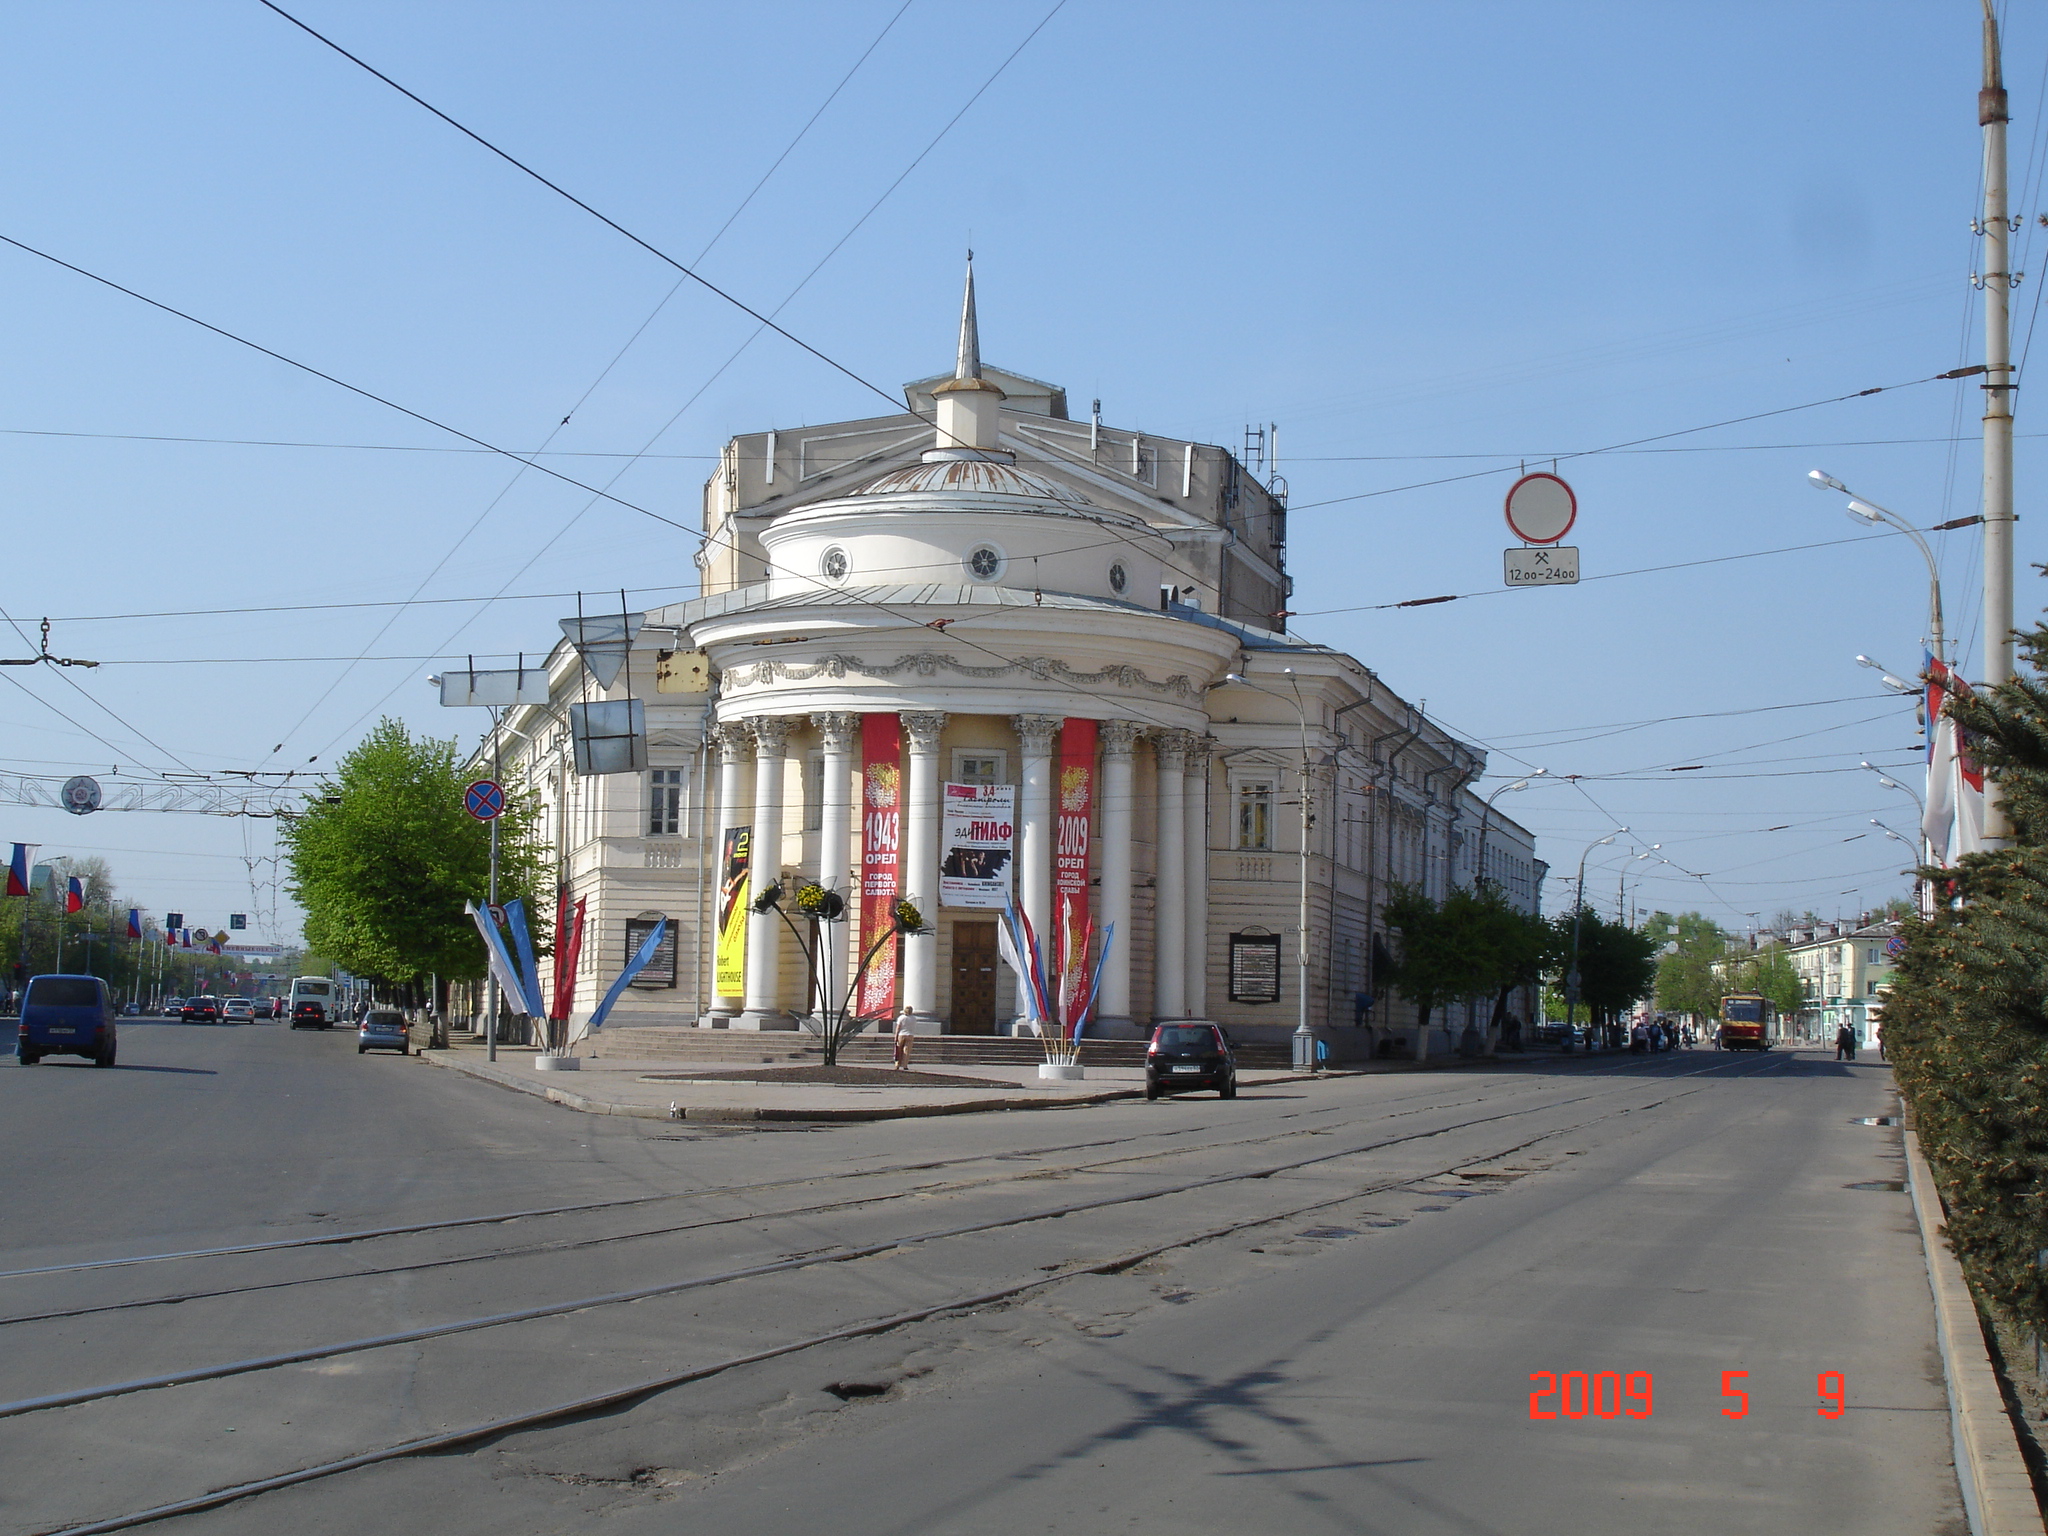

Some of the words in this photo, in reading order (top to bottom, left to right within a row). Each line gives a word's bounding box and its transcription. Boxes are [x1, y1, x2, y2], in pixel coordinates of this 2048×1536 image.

[865, 812, 899, 852] 1943
[970, 821, 1012, 841] ПИАФ
[1057, 815, 1088, 856] 2009
[737, 832, 749, 851] 2
[865, 853, 897, 865] ОРЕЛ
[1057, 857, 1085, 869] ОРЕЛ
[869, 873, 893, 881] ГОРОД
[1061, 871, 1080, 880] ГОРОД
[864, 880, 897, 888] ПЕРВОГО
[1060, 886, 1081, 894] СЛАВЫ
[865, 888, 896, 896] САЛЮТА
